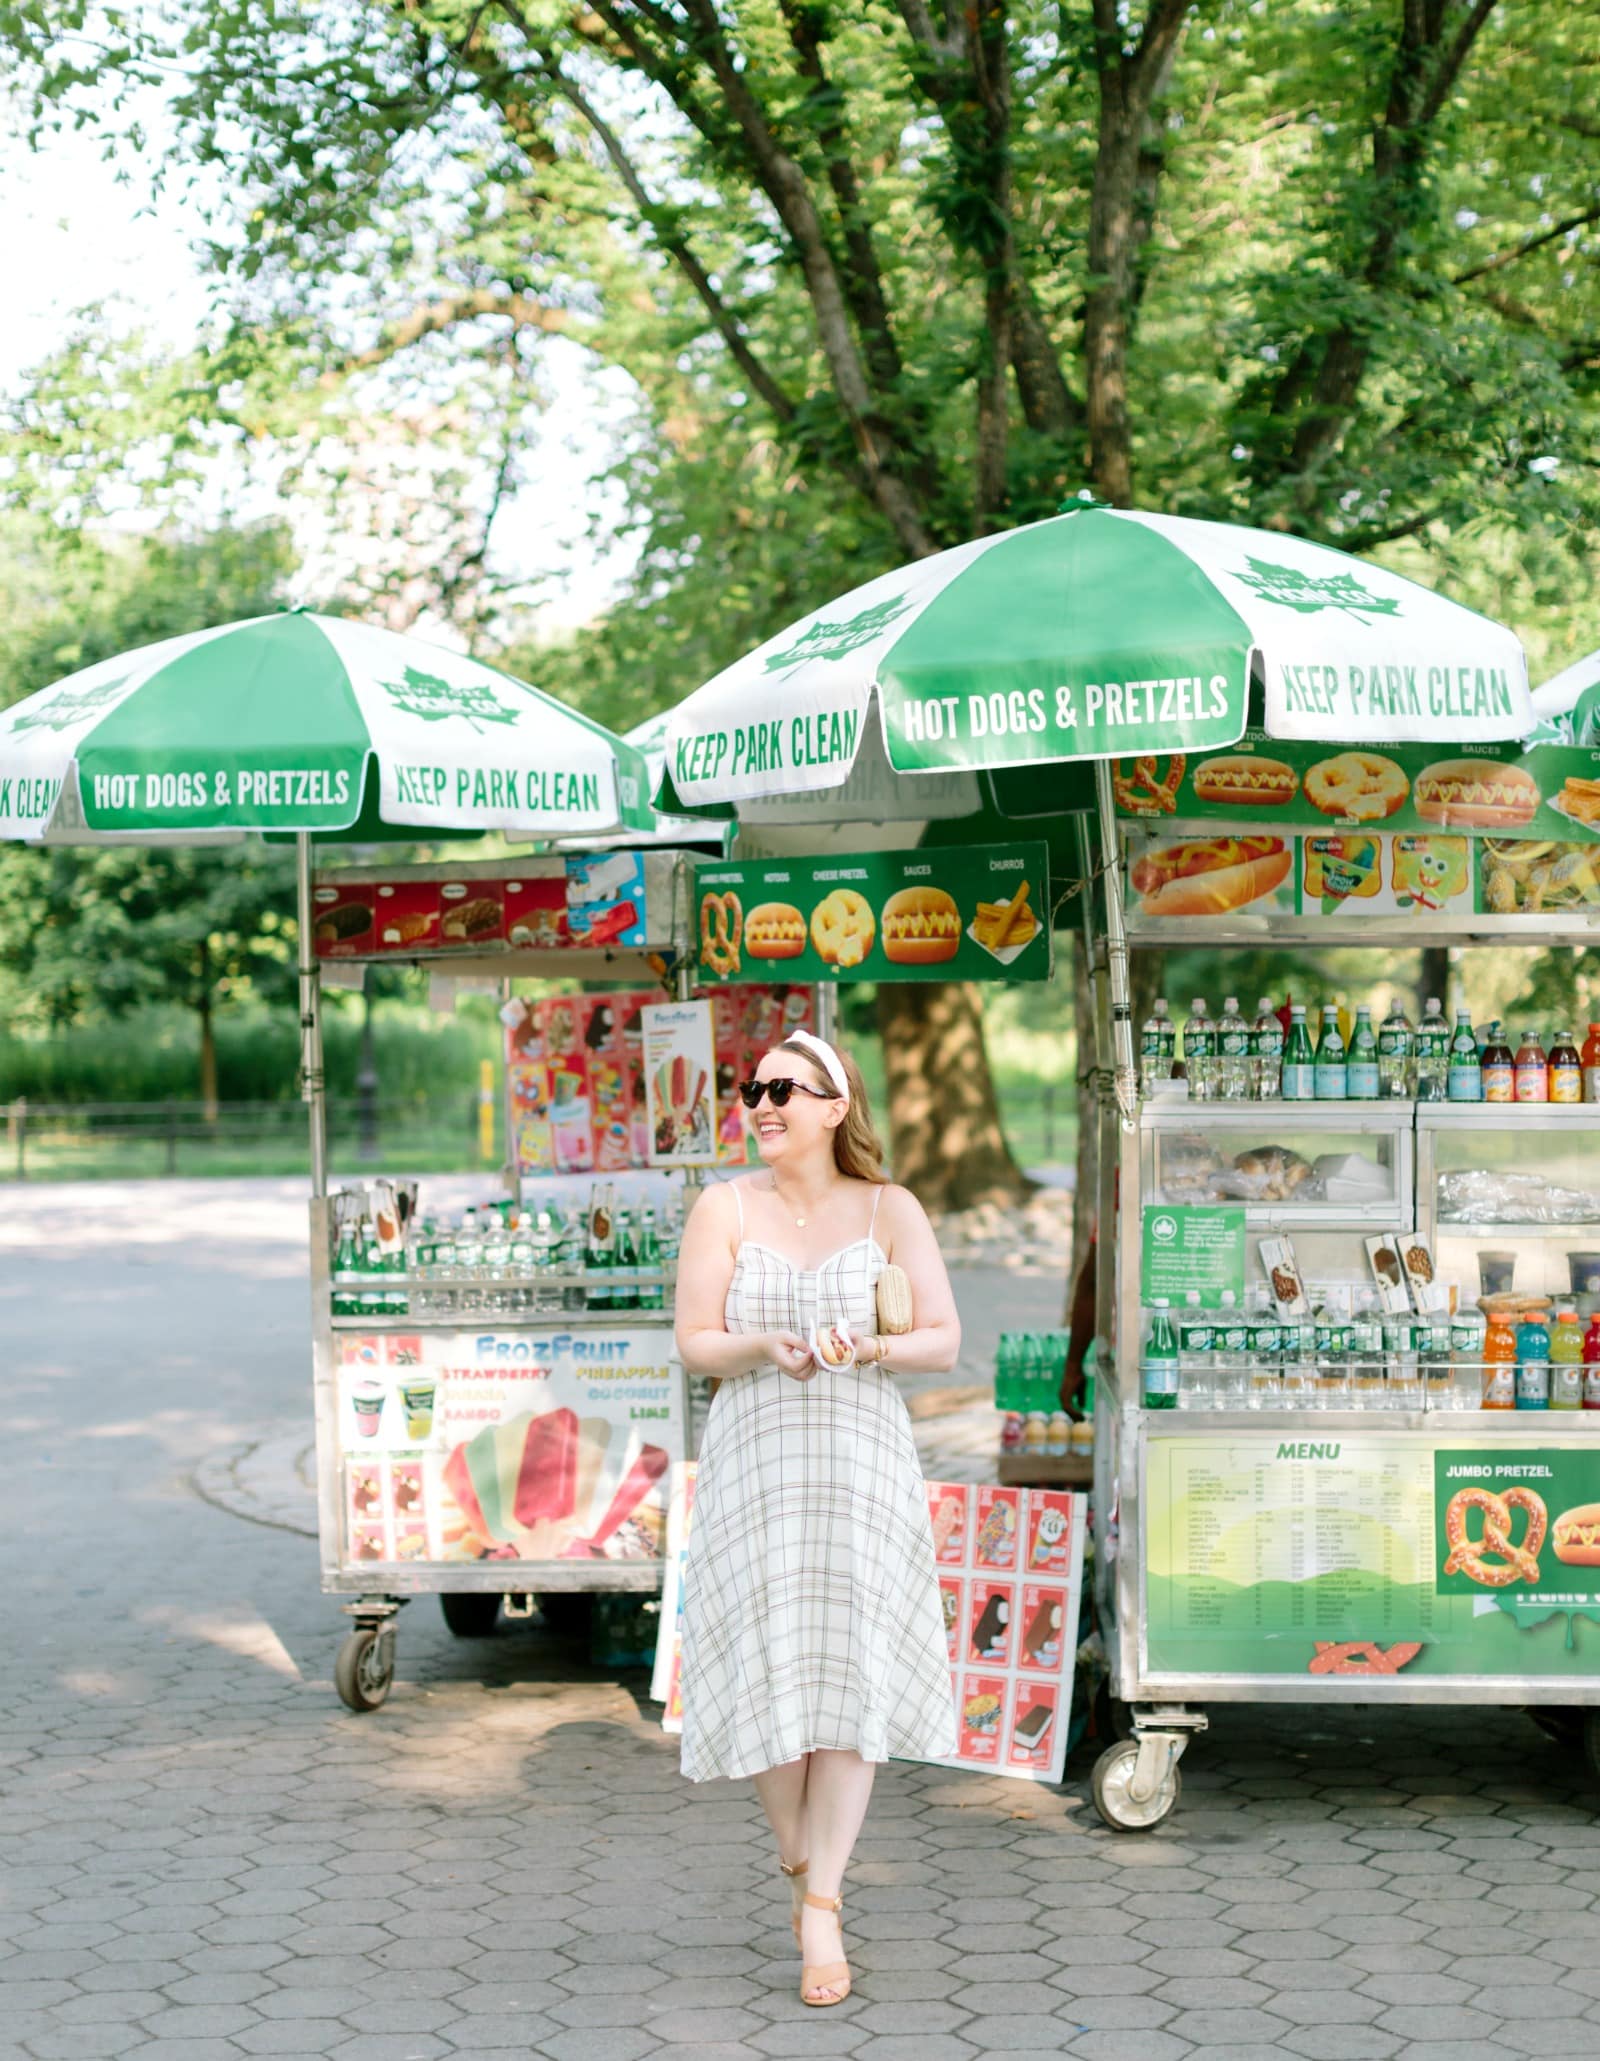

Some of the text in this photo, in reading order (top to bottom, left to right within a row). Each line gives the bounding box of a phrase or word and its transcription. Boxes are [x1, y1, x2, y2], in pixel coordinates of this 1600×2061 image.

[1281, 664, 1513, 717] KEEP PARK CLEAN
[903, 675, 1229, 742] HOT DOGS & PRETZELS
[676, 709, 858, 783] KEEP PARK CLEAN
[1461, 744, 1500, 754] SAUCES
[94, 774, 139, 810] HOT
[146, 771, 207, 808] DOGS
[214, 770, 232, 806] &
[237, 769, 349, 806] PRETZELS
[395, 763, 446, 806] KEEP
[456, 767, 519, 809] PARK
[527, 771, 600, 812] CLEAN
[904, 865, 932, 876] SAUCES
[989, 859, 1025, 871] CHURROS
[576, 1366, 669, 1380] PINEAPPLE
[1276, 1443, 1341, 1460] MENU
[1446, 1466, 1553, 1477] JUMBO PRETZEL
